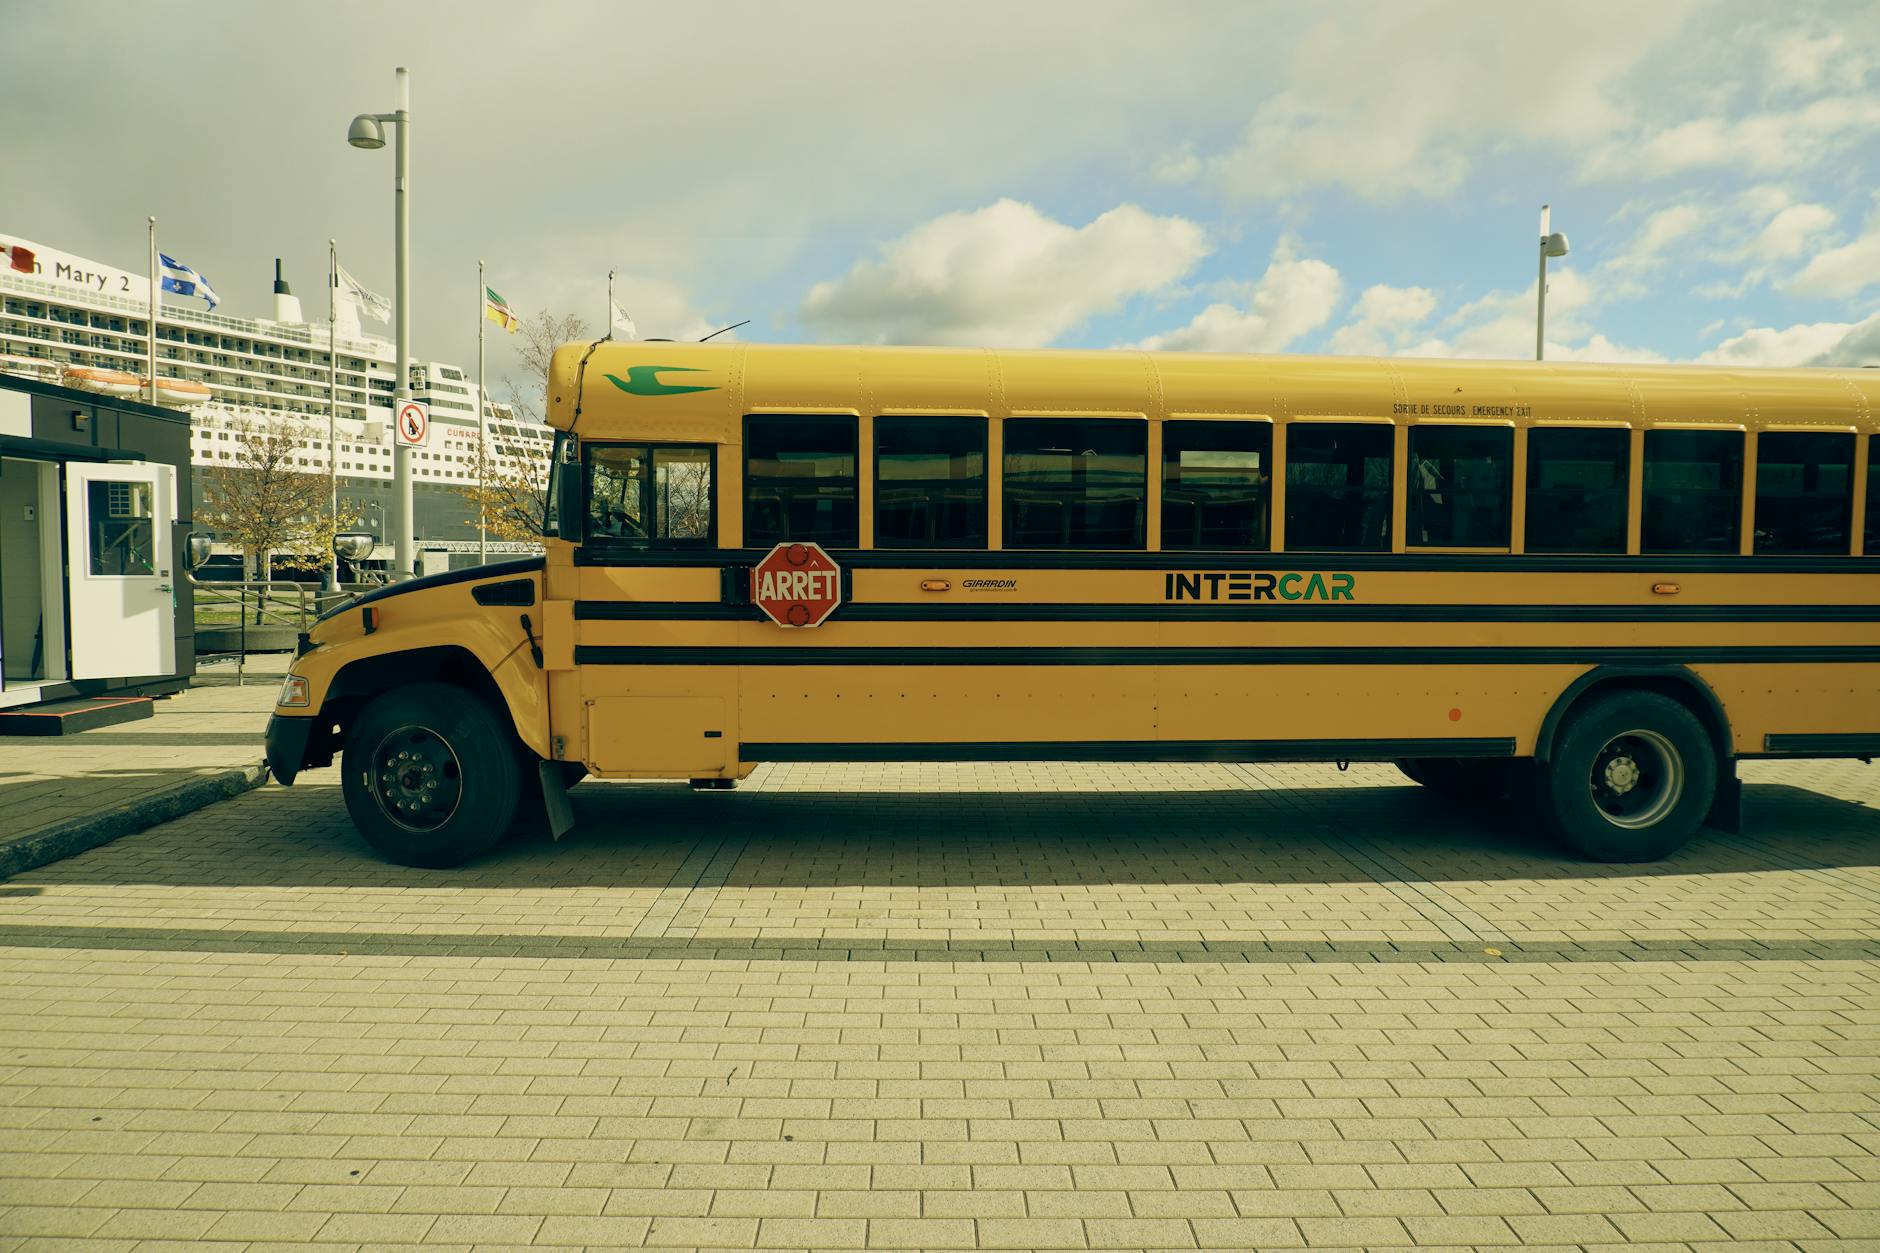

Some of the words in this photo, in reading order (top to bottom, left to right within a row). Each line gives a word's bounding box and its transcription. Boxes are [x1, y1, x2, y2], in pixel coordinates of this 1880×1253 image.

[56, 262, 107, 291] Mary
[120, 275, 130, 292] 2
[1393, 403, 1418, 414] SORTIE
[1421, 404, 1430, 414] DE
[1433, 404, 1466, 415] SECOURS
[1472, 405, 1514, 416] EMERGENCY
[1516, 406, 1531, 417] EXIT
[760, 560, 836, 601] ARRÊT
[962, 579, 1017, 588] GIRARDIN
[1165, 573, 1356, 600] INTERCAR
